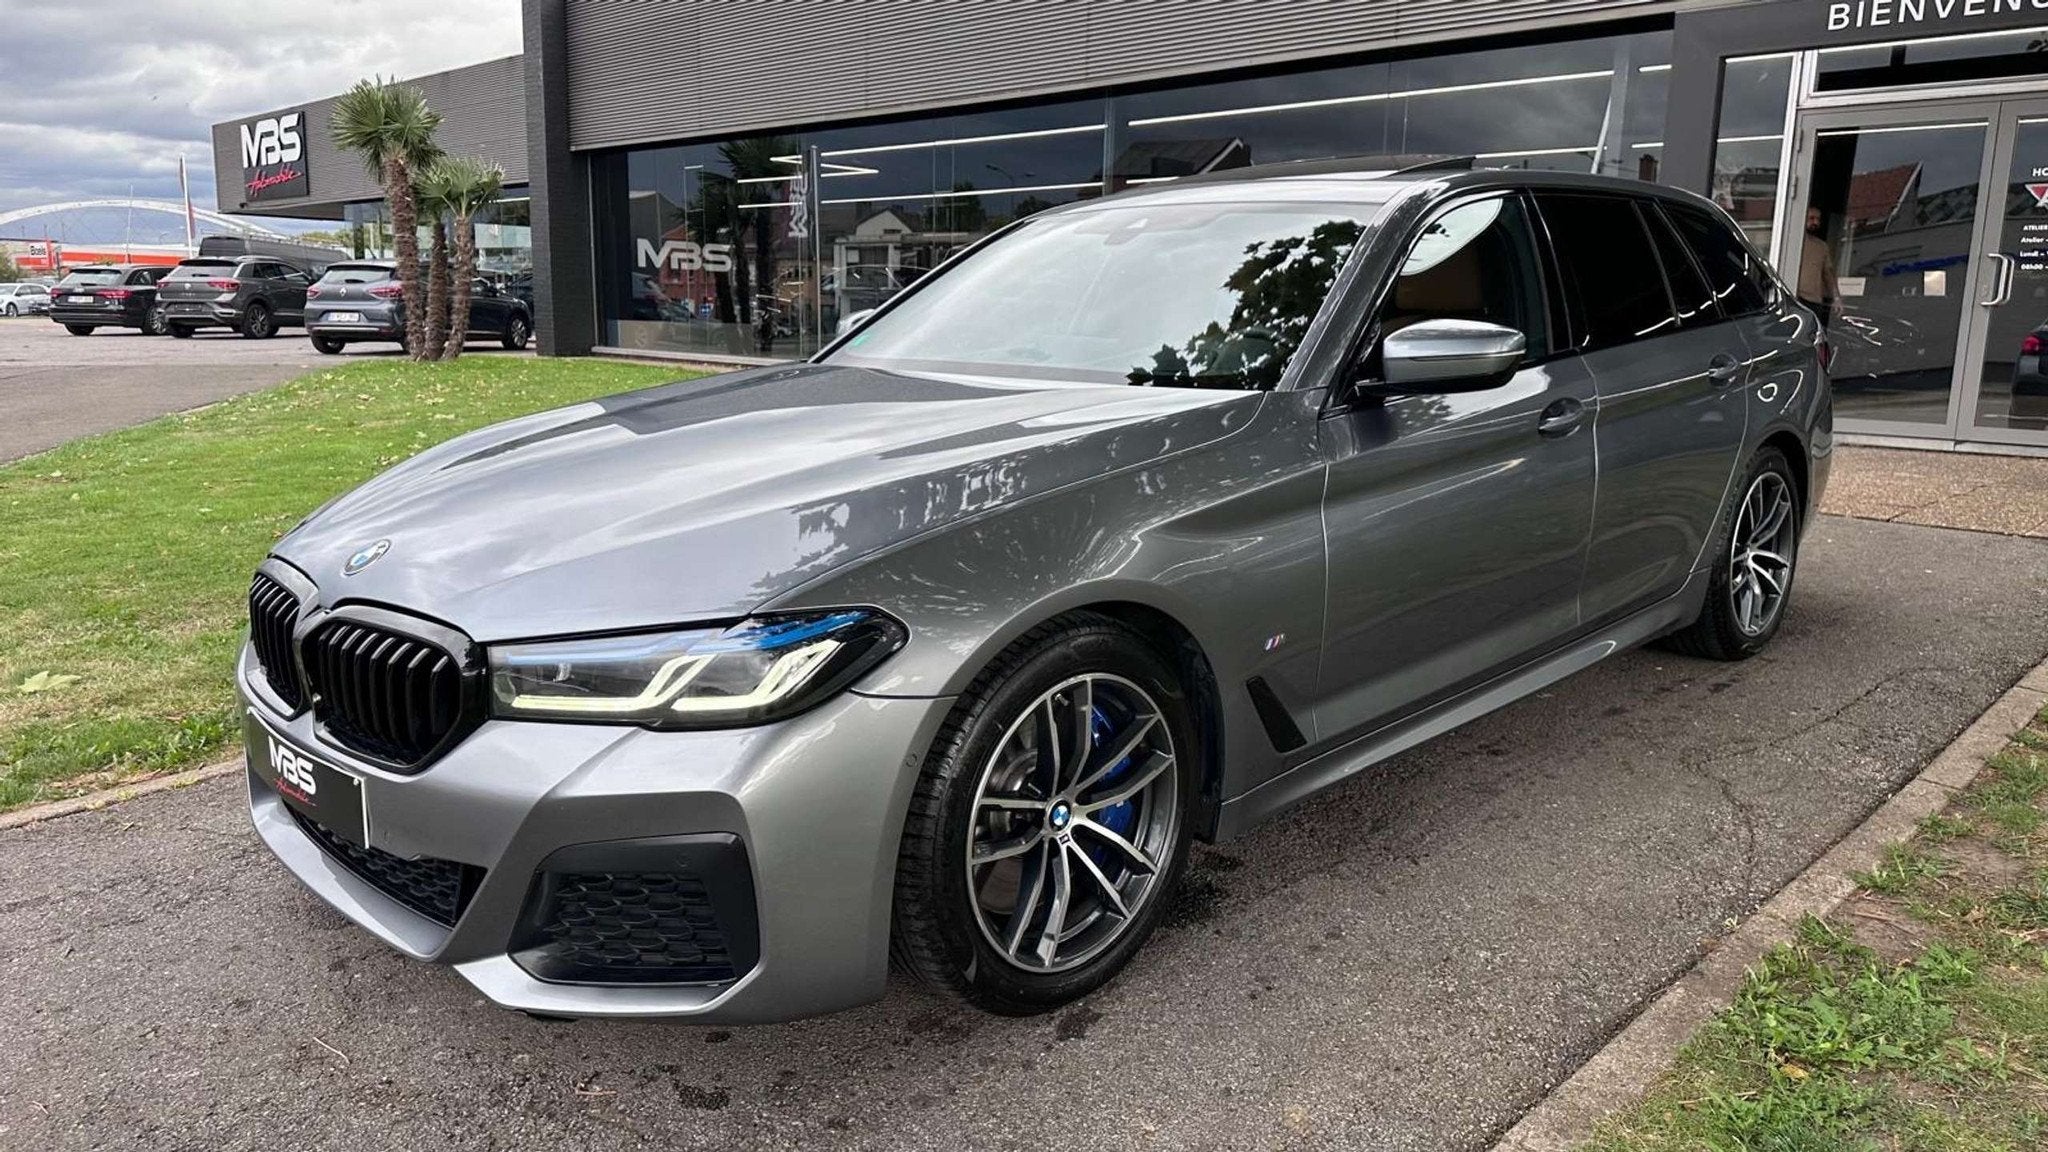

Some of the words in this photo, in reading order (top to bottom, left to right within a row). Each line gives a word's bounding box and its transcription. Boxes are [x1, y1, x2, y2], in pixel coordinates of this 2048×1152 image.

[240, 112, 302, 169] MBS
[636, 238, 732, 272] MBS
[267, 735, 316, 795] MBS
